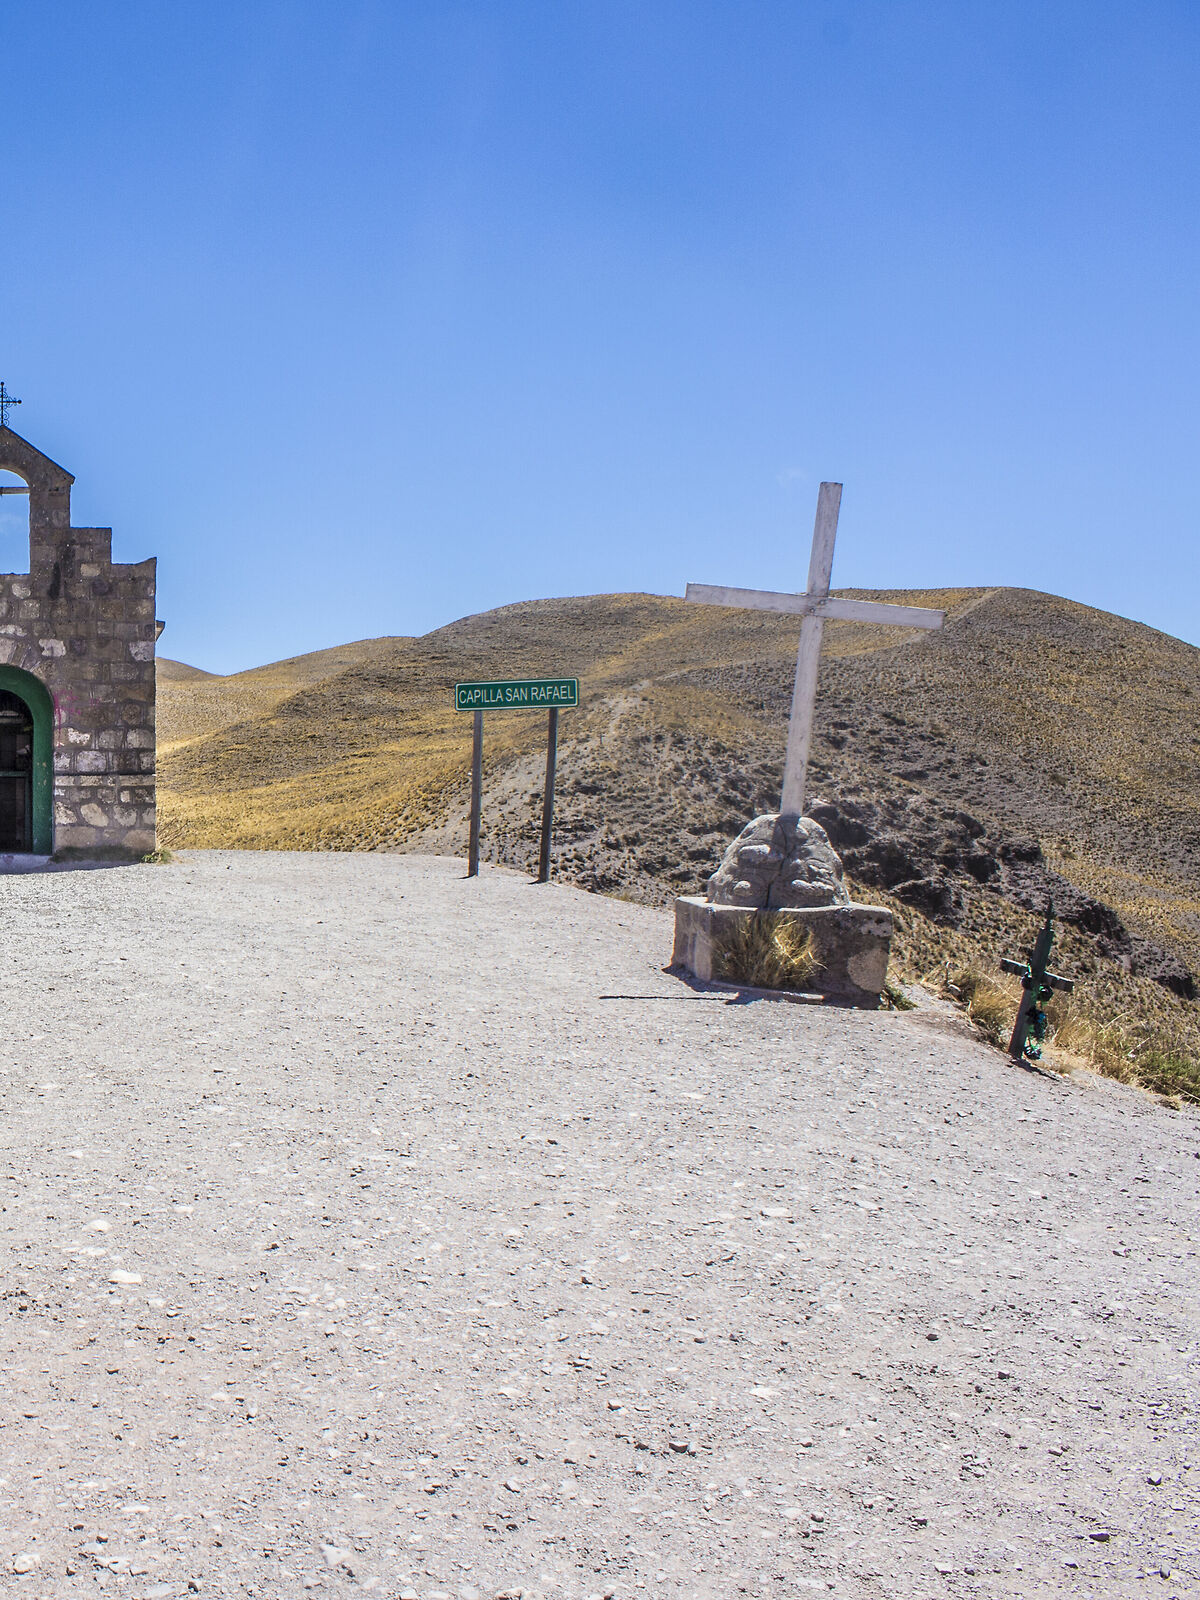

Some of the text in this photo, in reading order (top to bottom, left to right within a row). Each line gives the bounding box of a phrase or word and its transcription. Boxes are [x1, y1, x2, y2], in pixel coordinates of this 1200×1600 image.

[459, 685, 574, 704] CAPILLA SAN RAFAEL
